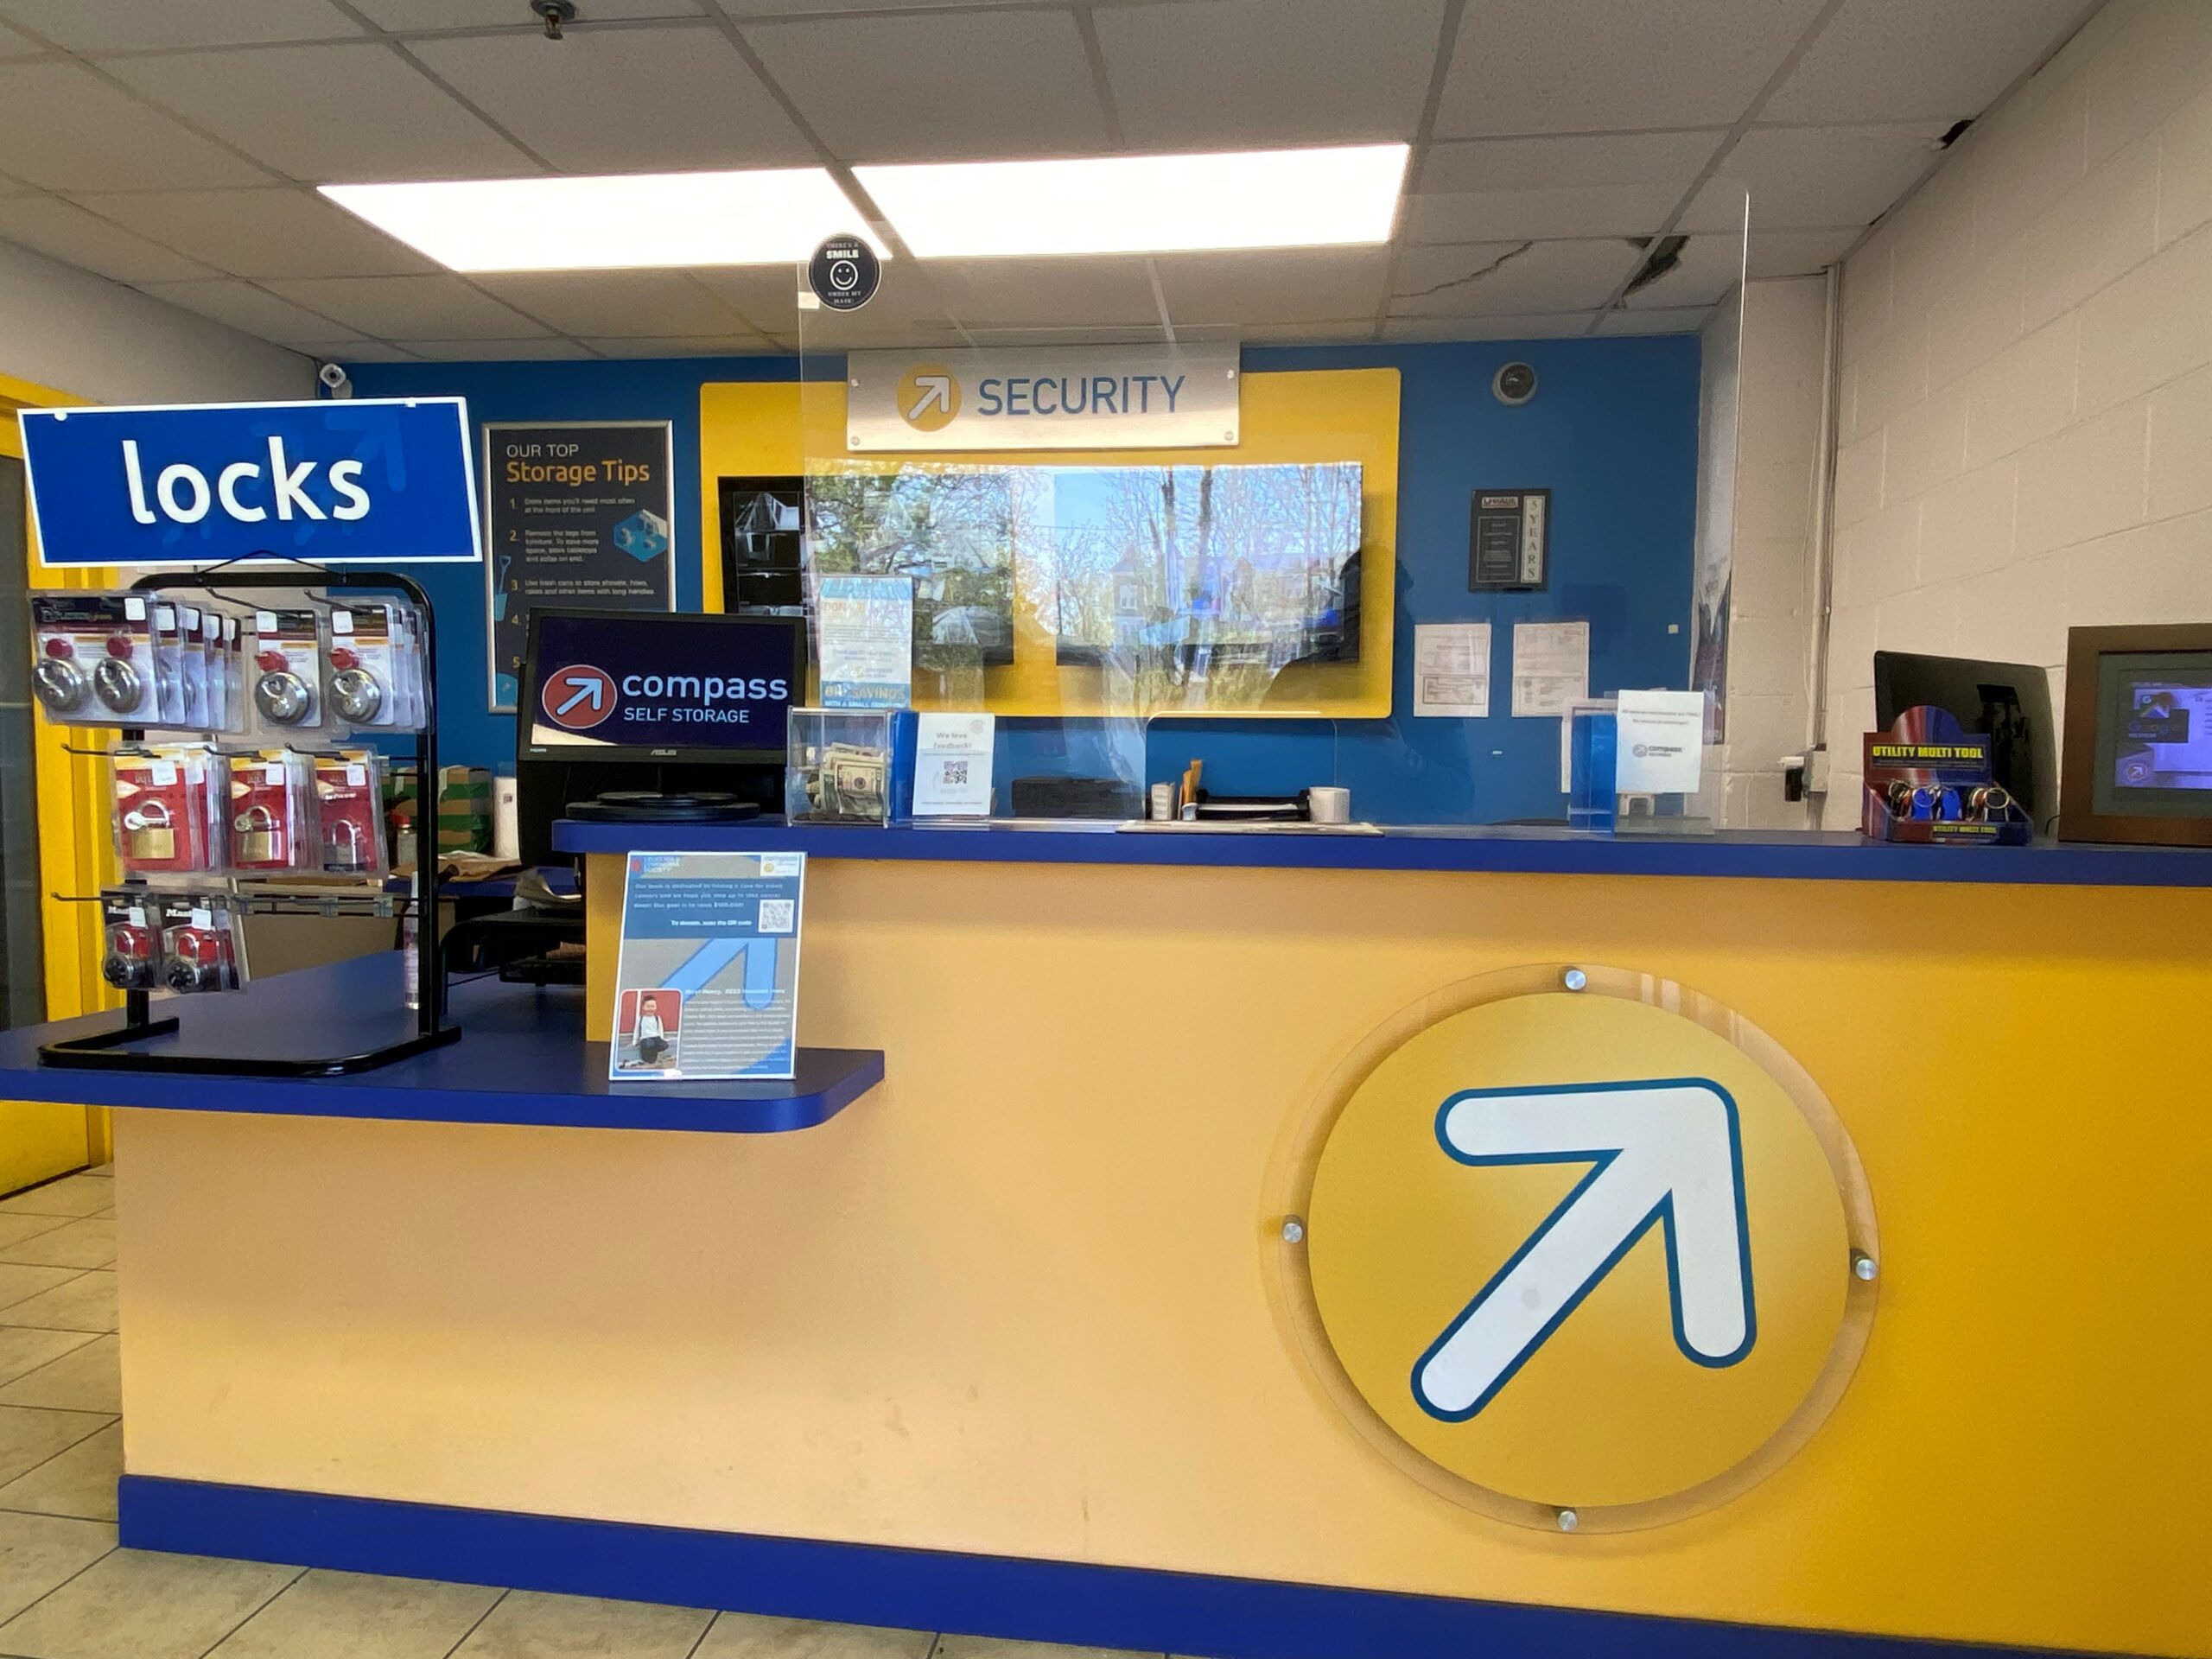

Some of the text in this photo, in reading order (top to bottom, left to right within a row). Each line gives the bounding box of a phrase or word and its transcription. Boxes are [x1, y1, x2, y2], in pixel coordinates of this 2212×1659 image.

[826, 249, 859, 259] SMILE
[977, 375, 1186, 416] SECURITY
[506, 443, 579, 458] OUR TOP
[122, 435, 371, 524] locks
[506, 458, 650, 486] Storage Tips
[622, 674, 788, 706] compass
[623, 707, 750, 723] SELF STORAGE
[1872, 746, 1984, 759] UTILITY MULTI TOOL
